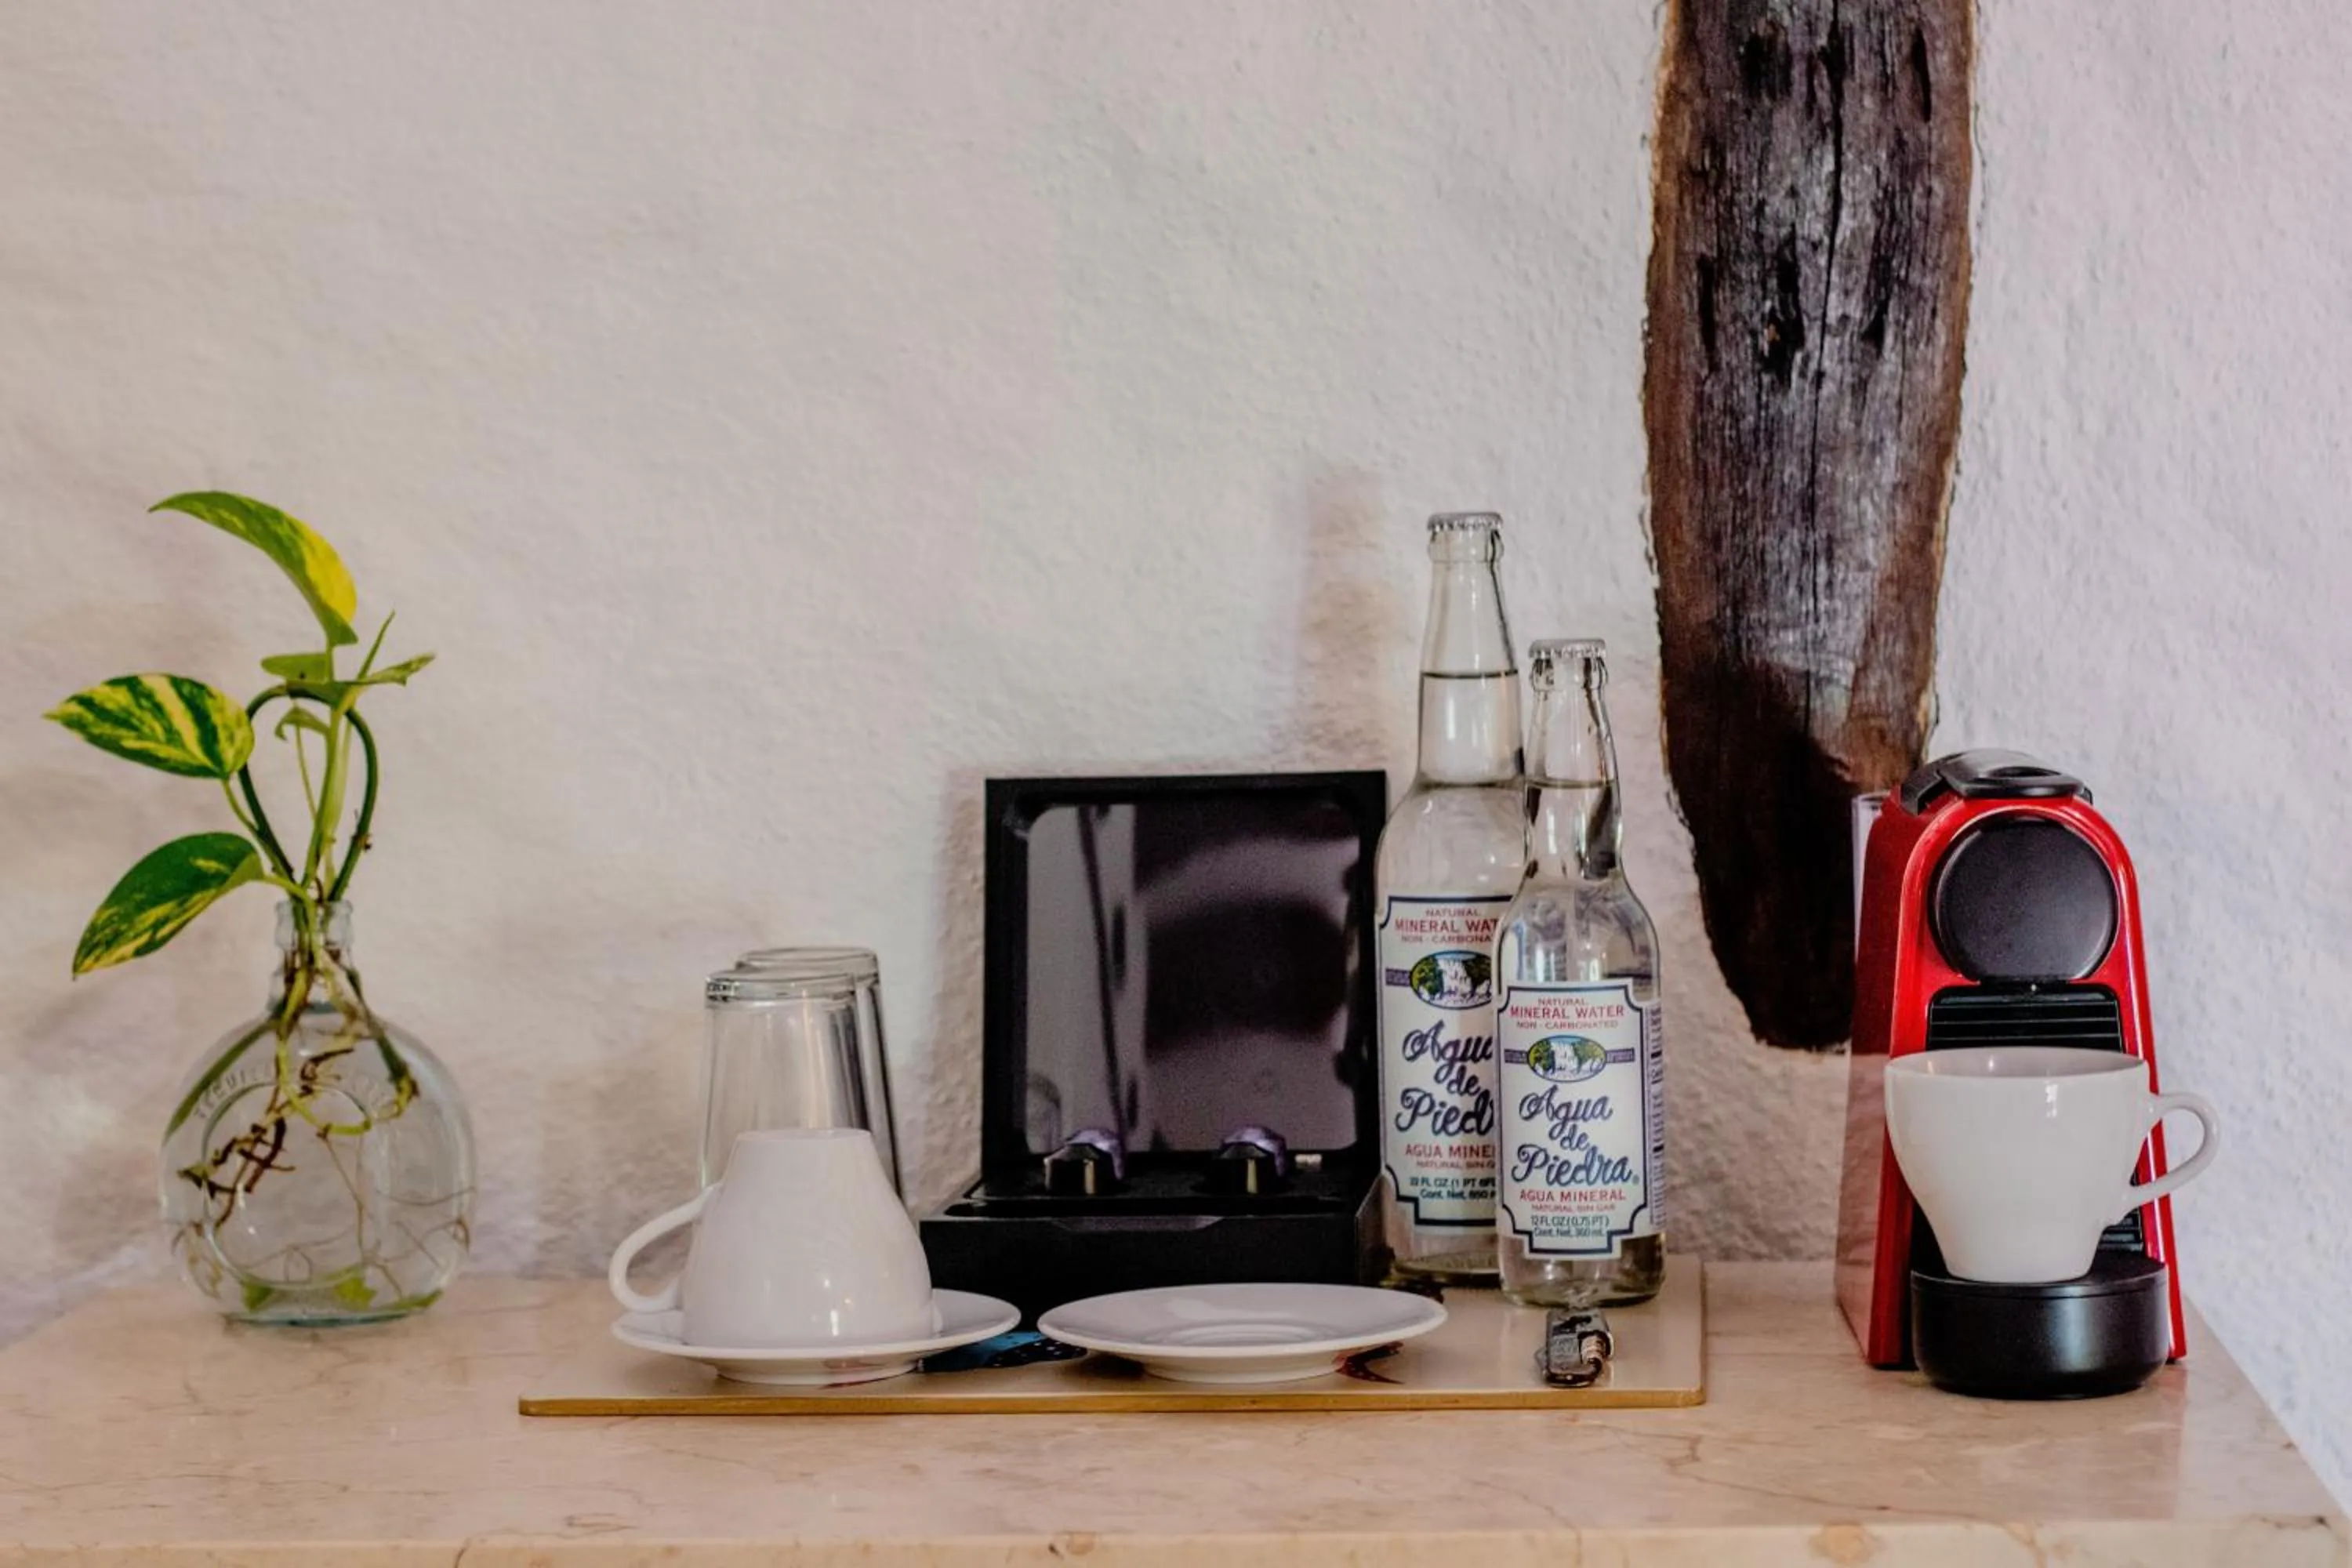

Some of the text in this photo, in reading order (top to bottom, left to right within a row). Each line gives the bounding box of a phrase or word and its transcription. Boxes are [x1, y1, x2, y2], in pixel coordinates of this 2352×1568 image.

[1396, 918, 1498, 933] MINERAL WAT
[1432, 935, 1491, 943] CARBONA
[1538, 996, 1588, 1006] NATURAL
[1510, 1005, 1624, 1019] MINERAL WATER
[1516, 1021, 1537, 1029] NON
[1446, 1064, 1481, 1097] de
[1394, 1087, 1494, 1137] Pied
[1518, 1083, 1613, 1141] Agua
[1559, 1123, 1591, 1152] de
[1405, 1144, 1496, 1159] AGUA MINE
[1510, 1142, 1633, 1187] Piedra
[1519, 1188, 1627, 1202] AGUA MINERAL
